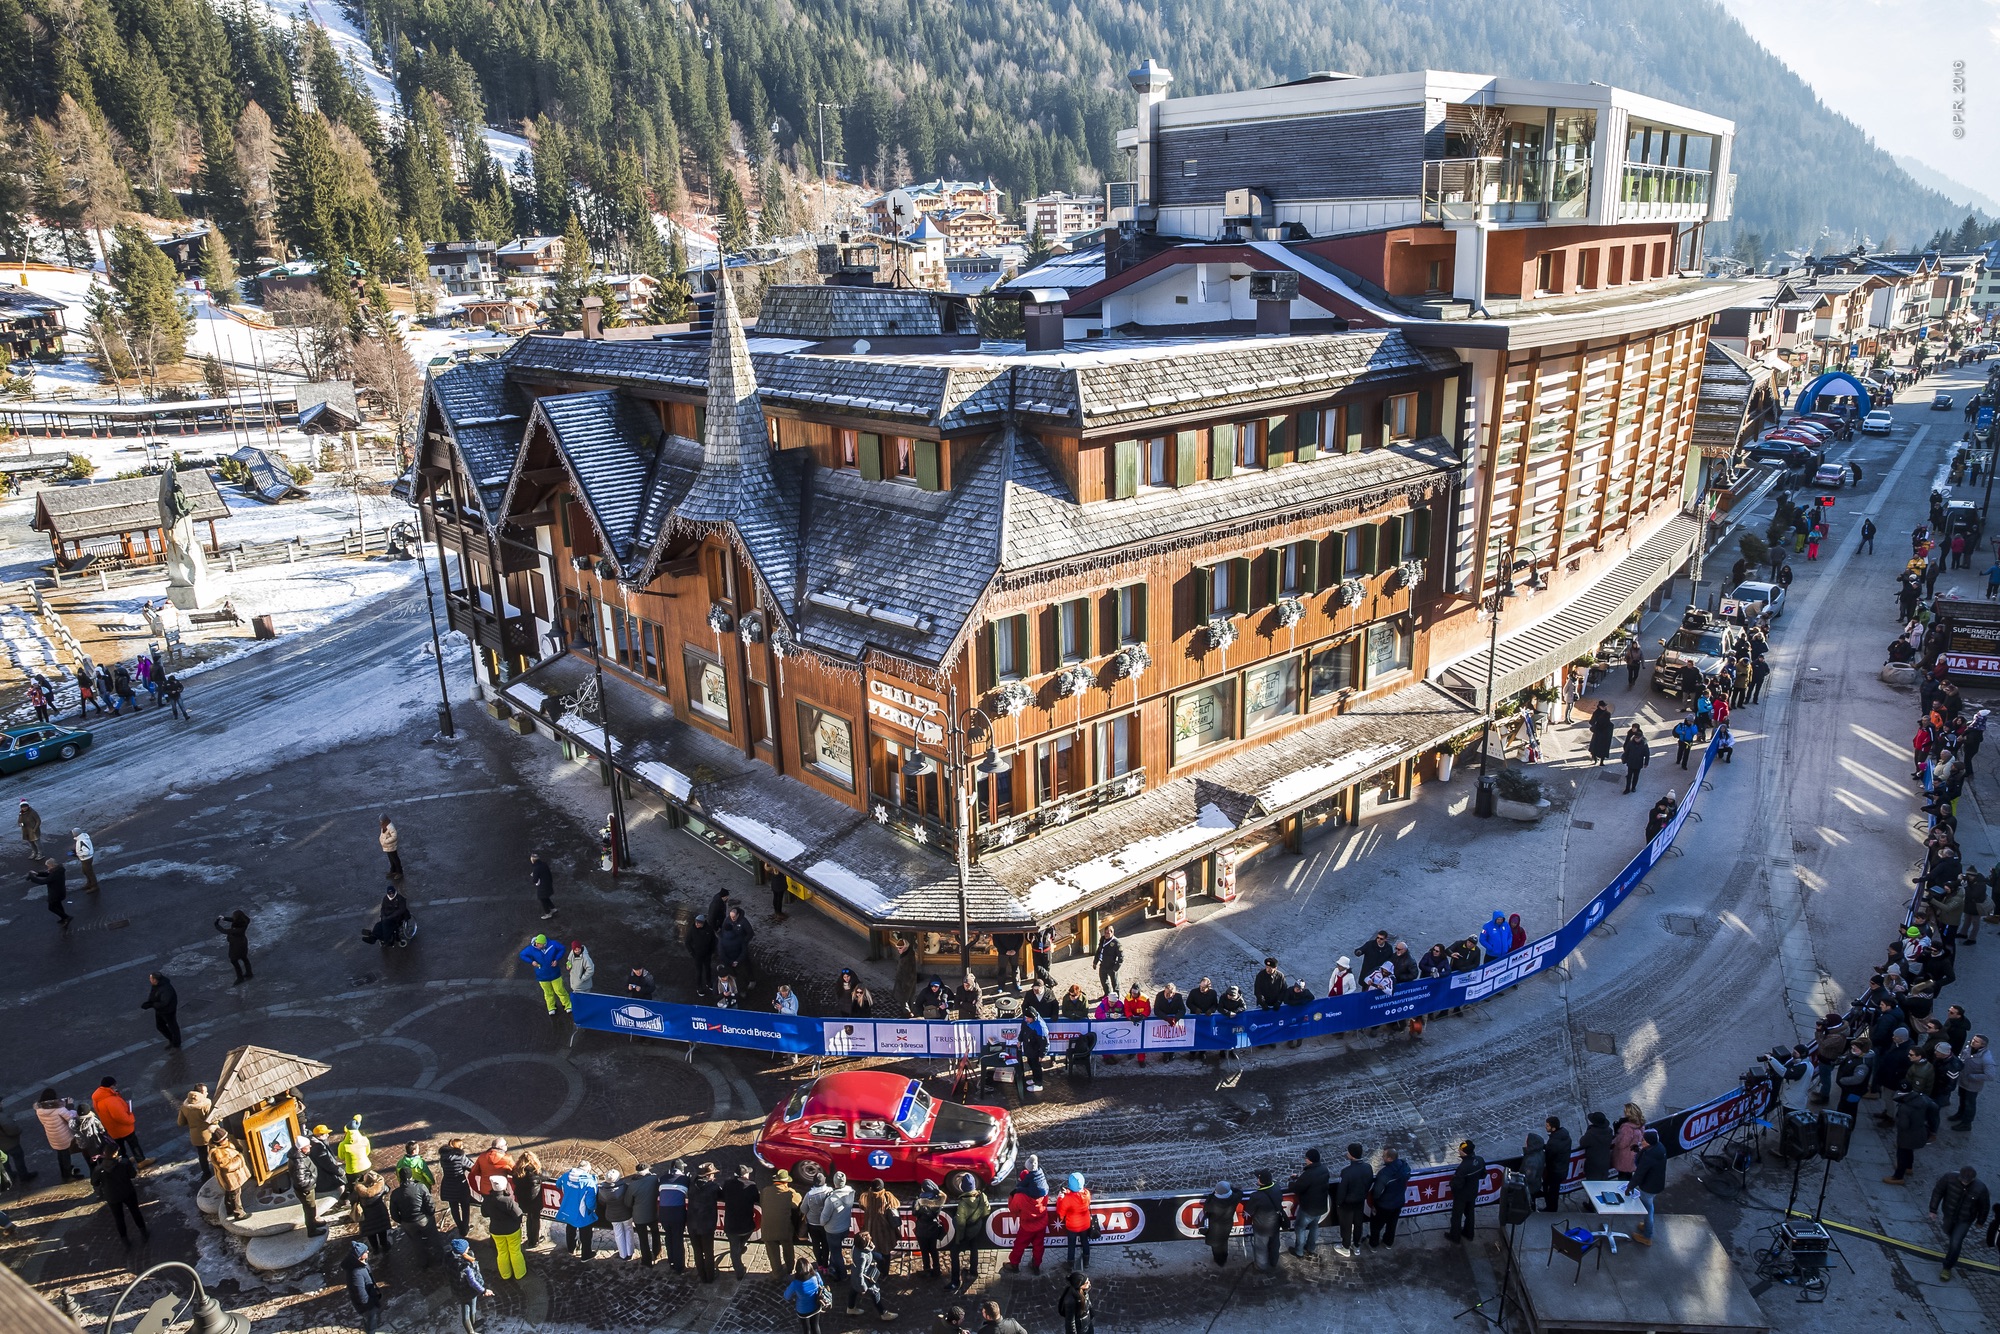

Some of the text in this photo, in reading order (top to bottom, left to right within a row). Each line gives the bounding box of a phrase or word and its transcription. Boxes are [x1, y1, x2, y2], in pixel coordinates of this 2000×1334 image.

[1977, 659, 2000, 671] FR
[870, 680, 939, 717] CHALET
[613, 1010, 635, 1027] WINTER
[635, 1016, 662, 1031] MARATHON
[692, 1021, 782, 1039] UBI Banco di Brescia
[1690, 1111, 1719, 1138] MA
[872, 1155, 888, 1165] 17
[1437, 1174, 1493, 1199] FA
[1420, 1204, 1433, 1214] per
[1050, 1238, 1066, 1247] per
